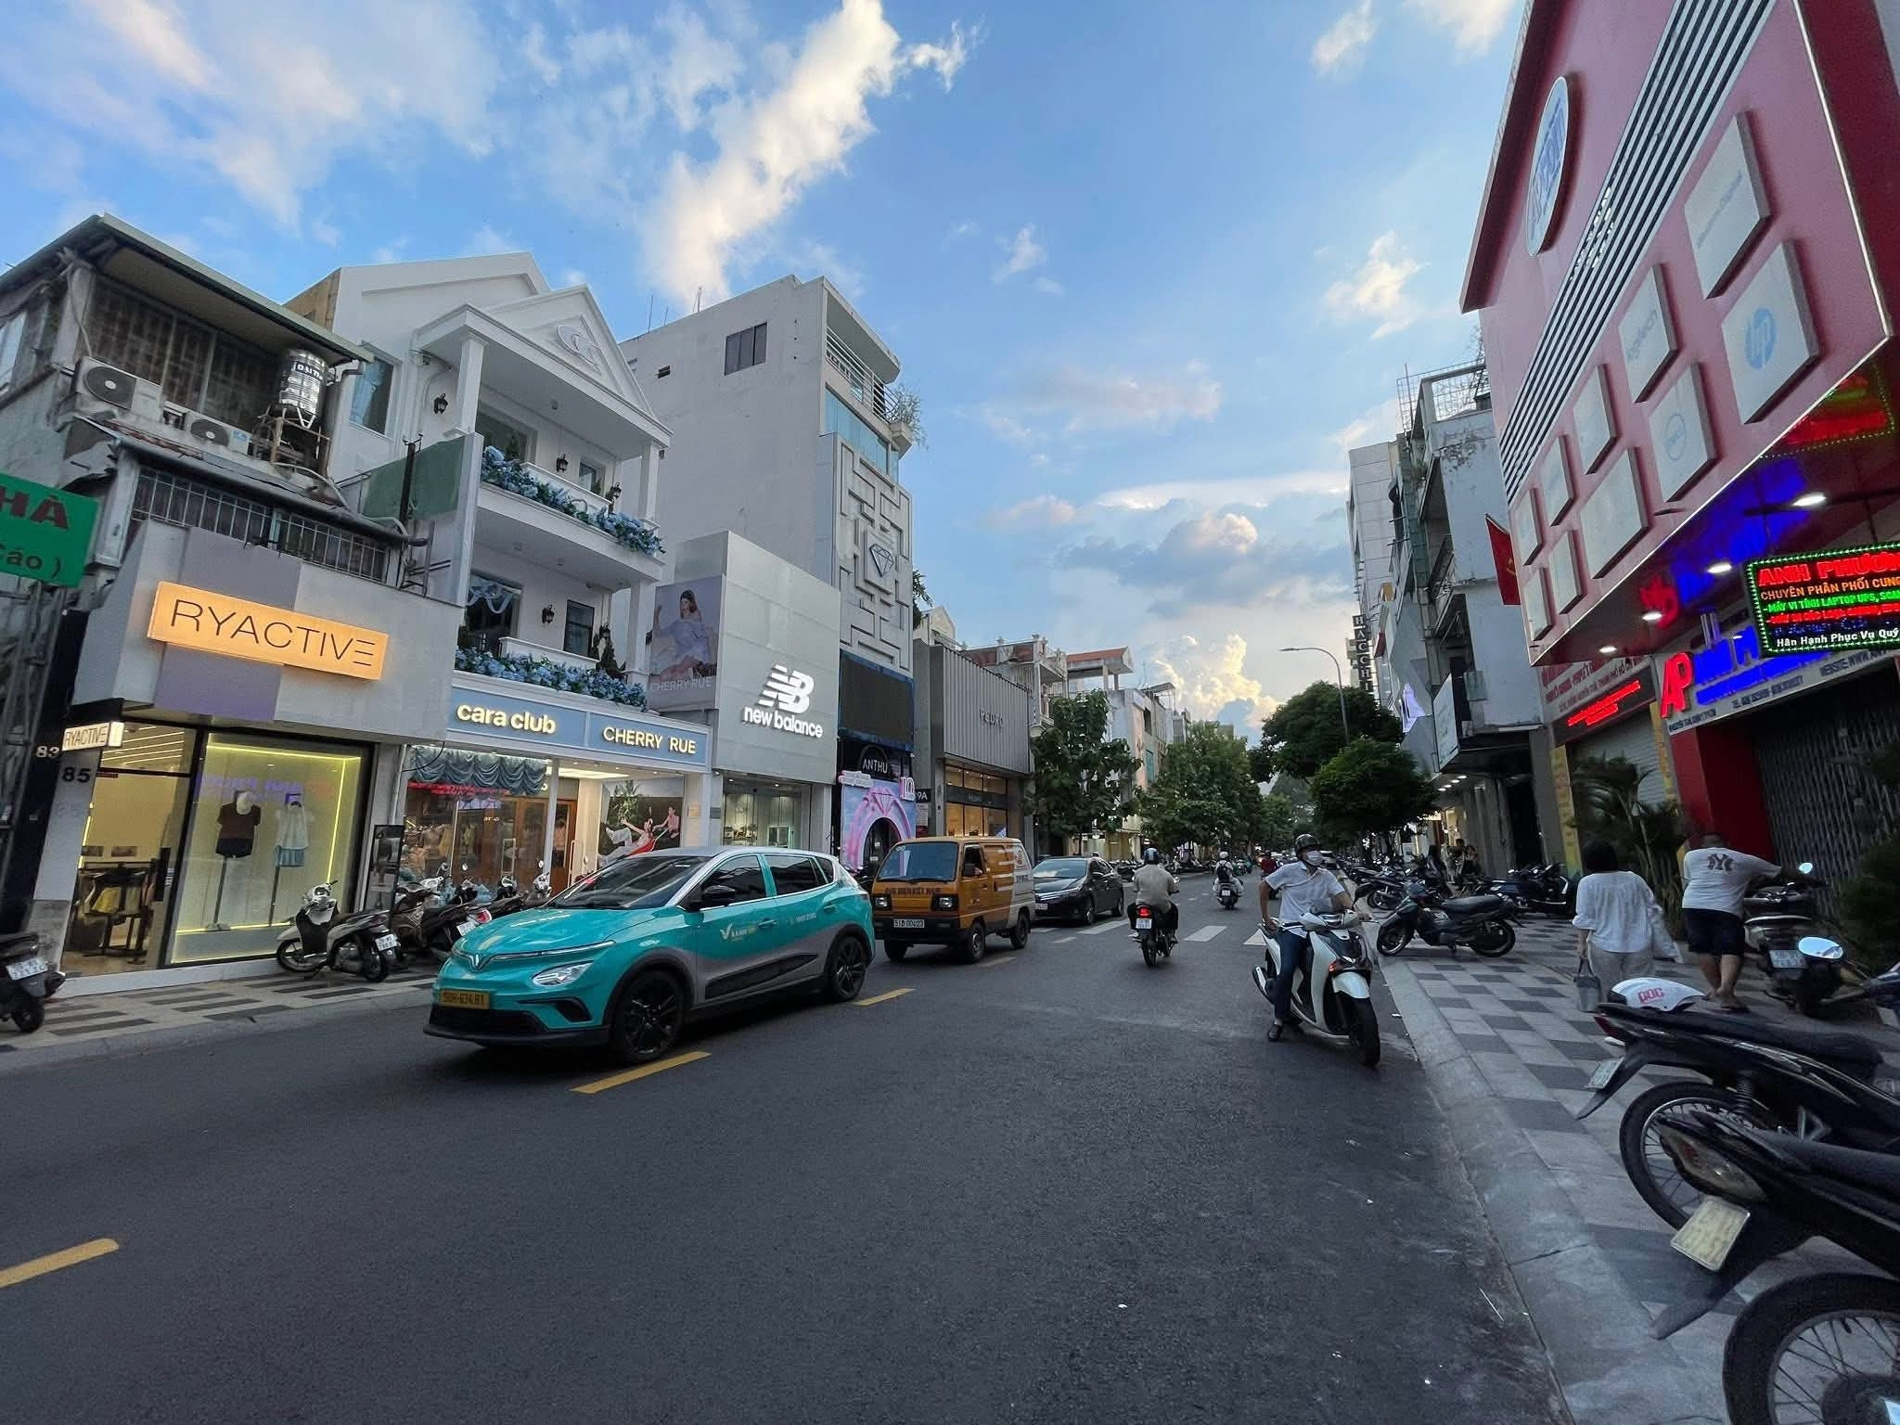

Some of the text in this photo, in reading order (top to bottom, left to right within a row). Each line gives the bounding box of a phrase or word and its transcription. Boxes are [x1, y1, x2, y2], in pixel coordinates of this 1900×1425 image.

[1759, 564, 1811, 586] ANH
[1760, 586, 1805, 600] CHUYÊN
[1807, 582, 1840, 595] PHÂN
[1841, 576, 1870, 592] PHỐI
[1821, 595, 1857, 607] LAPTOP
[171, 599, 376, 667] RYACTIVE
[1777, 627, 1899, 647] Hân Hạnh Phục Vụ Quý
[649, 676, 712, 691] CHERRY RUE
[456, 704, 557, 735] cara club
[743, 706, 824, 739] new balance
[64, 725, 108, 748] RYACTIVE
[603, 726, 697, 755] CHERRY RUE
[62, 766, 91, 783] 85
